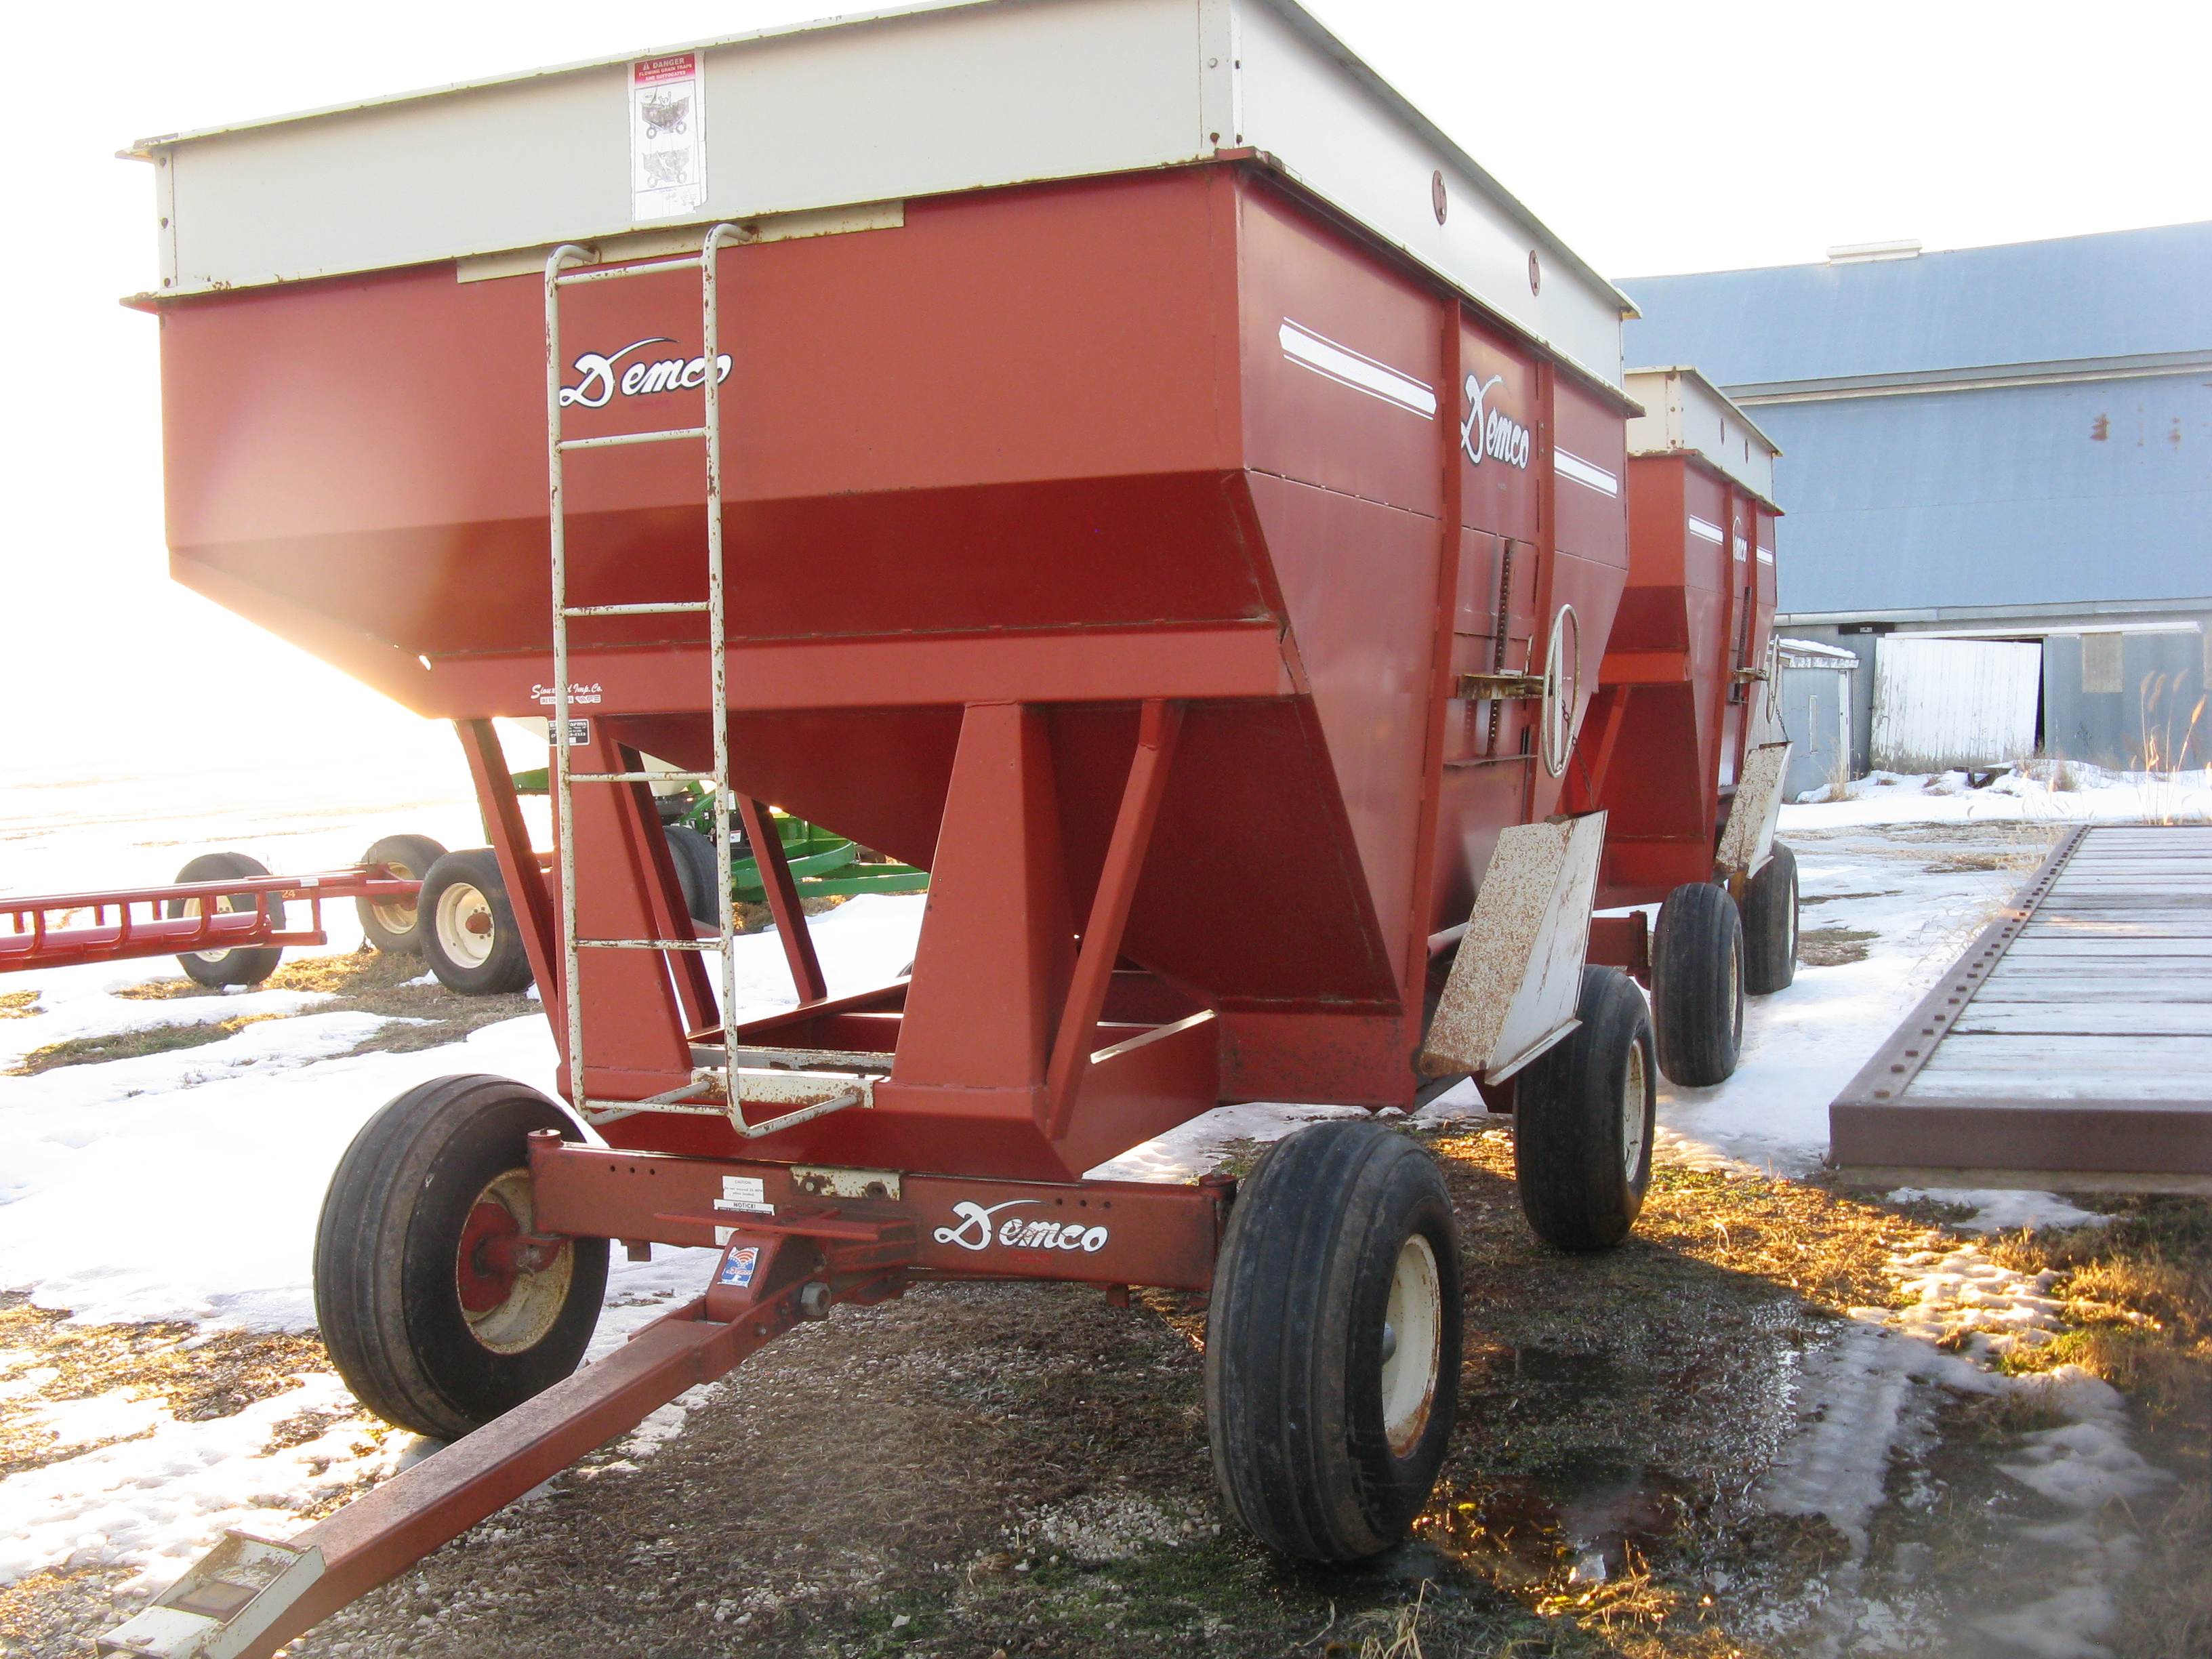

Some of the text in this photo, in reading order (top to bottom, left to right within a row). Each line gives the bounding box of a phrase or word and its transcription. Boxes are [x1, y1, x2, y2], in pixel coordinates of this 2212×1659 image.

[653, 58, 684, 68] DANGER
[559, 337, 733, 408] Demco
[1460, 374, 1530, 470] Demco
[933, 1200, 1109, 1253] Demco
